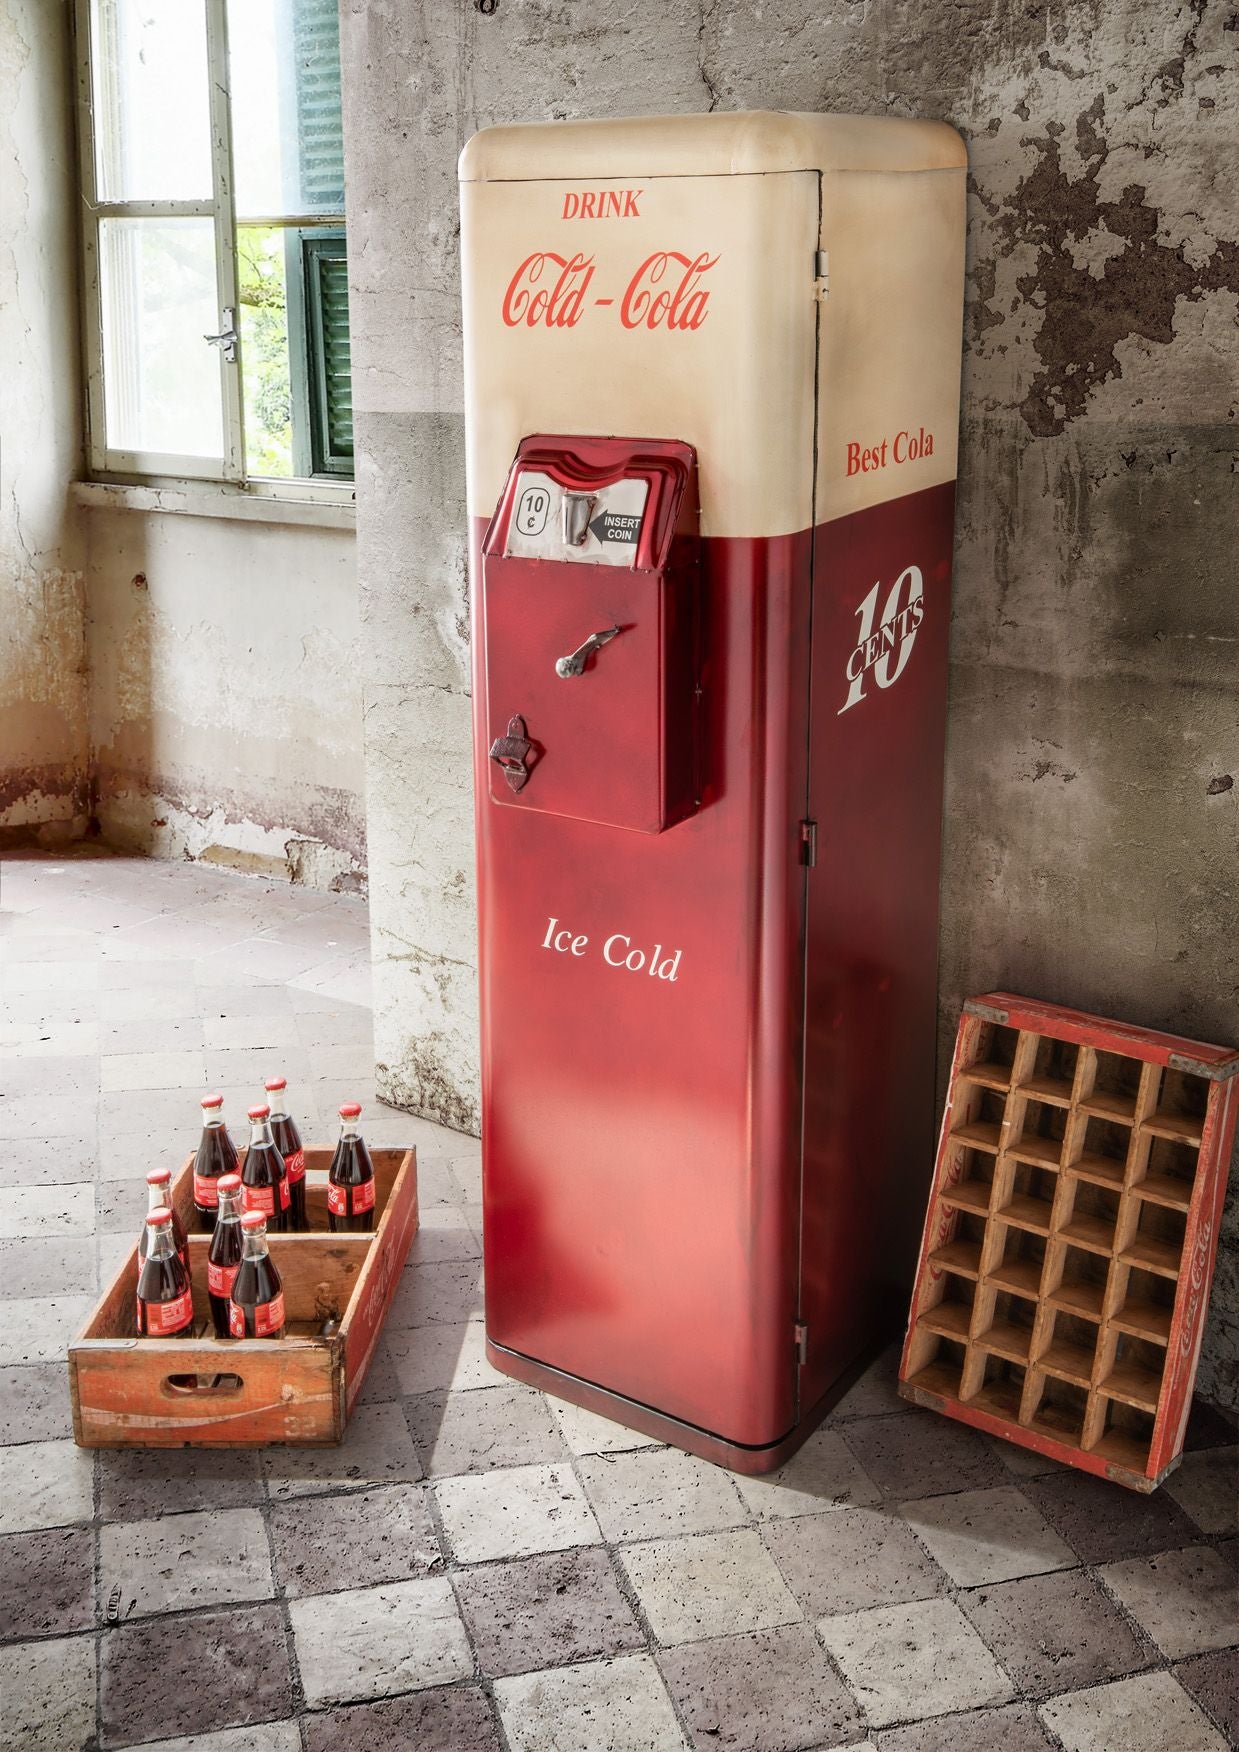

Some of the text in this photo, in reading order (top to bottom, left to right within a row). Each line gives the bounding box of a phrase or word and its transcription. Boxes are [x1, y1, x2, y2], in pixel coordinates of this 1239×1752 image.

[561, 189, 644, 219] DRINK
[620, 251, 722, 331] Cola
[845, 427, 934, 478] Best Cola
[526, 494, 544, 513] 10
[604, 515, 640, 529] INSERT
[607, 528, 632, 541] COIN
[837, 565, 923, 715] 10
[846, 596, 924, 681] CENTS
[541, 917, 682, 982] Ice Cold
